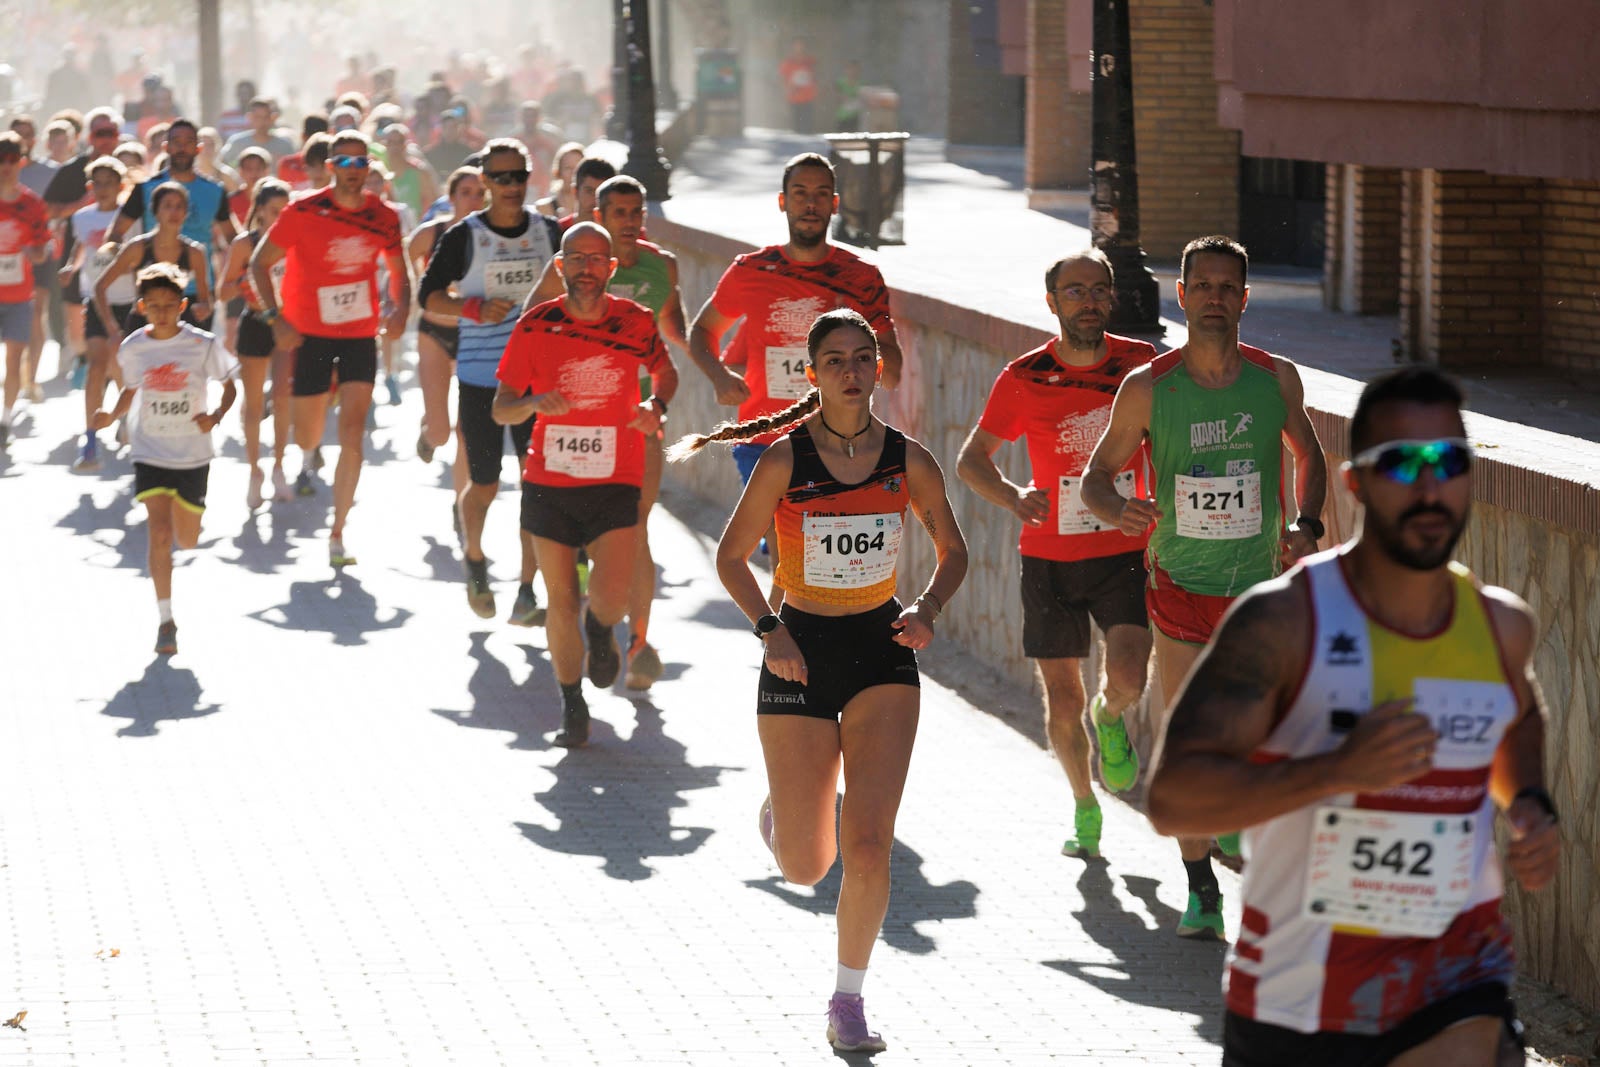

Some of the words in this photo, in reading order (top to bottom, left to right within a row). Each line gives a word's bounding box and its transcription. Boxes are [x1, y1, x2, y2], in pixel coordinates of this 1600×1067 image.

[496, 269, 533, 284] 1655
[332, 291, 357, 305] 127
[150, 400, 189, 415] 1580
[1190, 420, 1228, 448] ATARFE
[556, 438, 602, 453] 1466
[1188, 490, 1244, 510] 1271
[820, 531, 885, 555] 1064
[1352, 838, 1434, 877] 542
